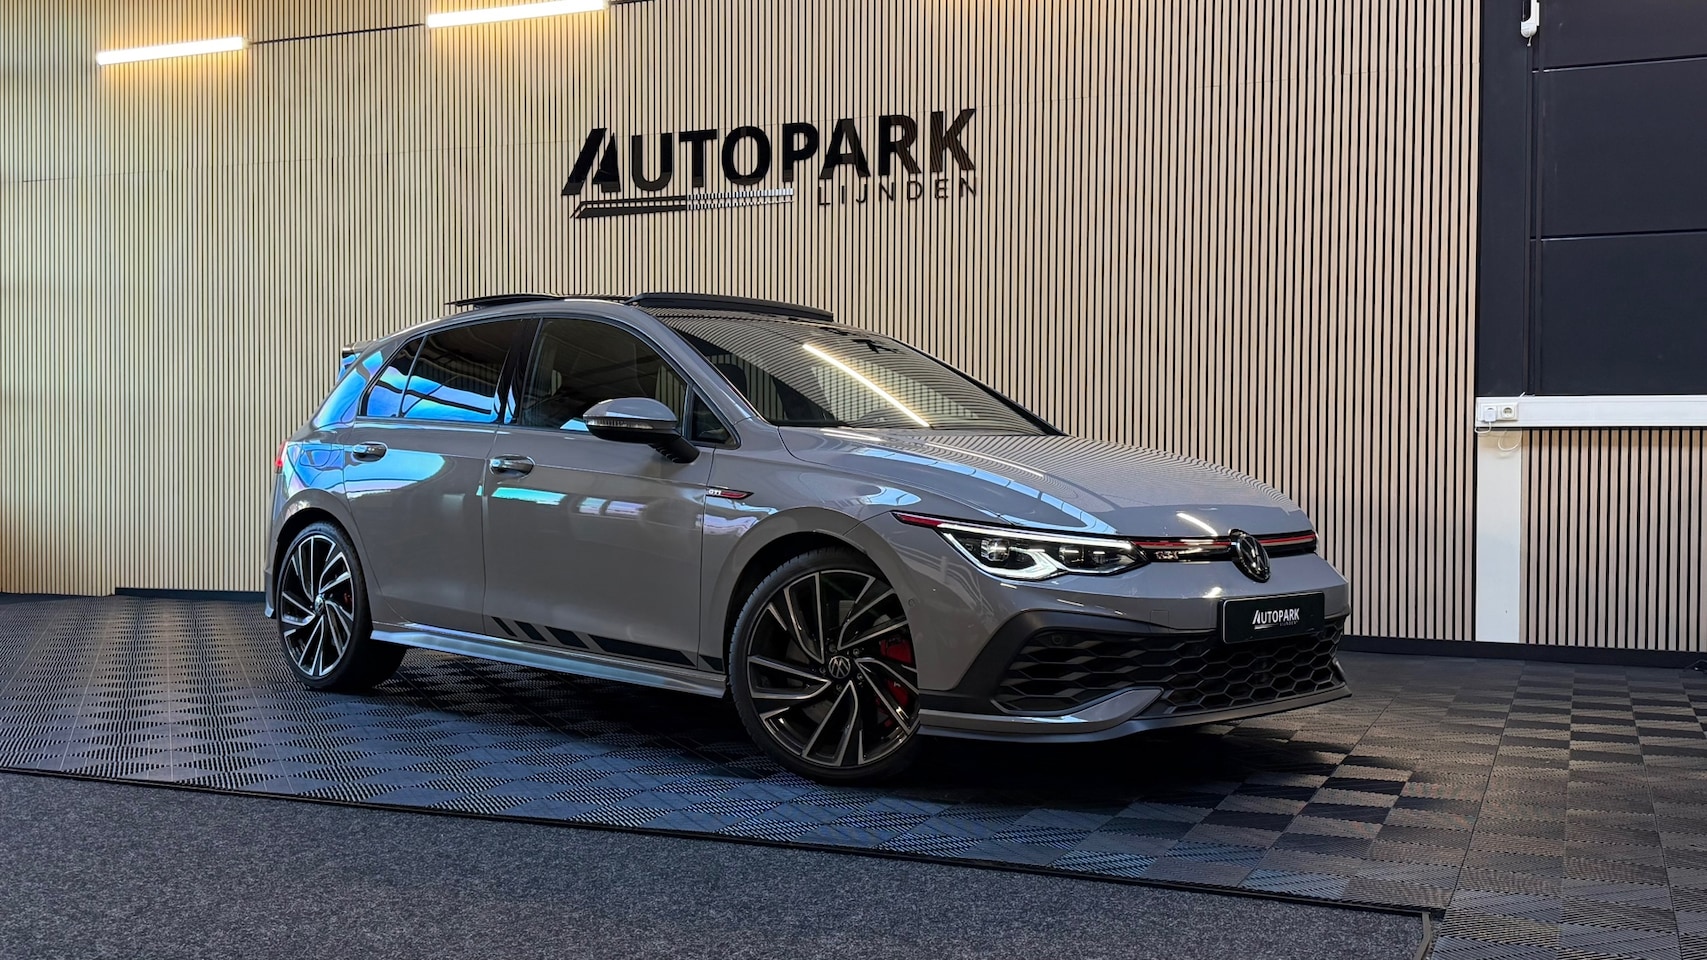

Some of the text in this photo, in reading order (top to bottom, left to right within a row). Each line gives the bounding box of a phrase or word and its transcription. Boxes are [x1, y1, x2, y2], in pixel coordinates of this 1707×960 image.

[561, 108, 977, 196] AUTOPARK
[818, 177, 977, 206] LIJNDEN
[1252, 607, 1300, 625] AUTOPARK
